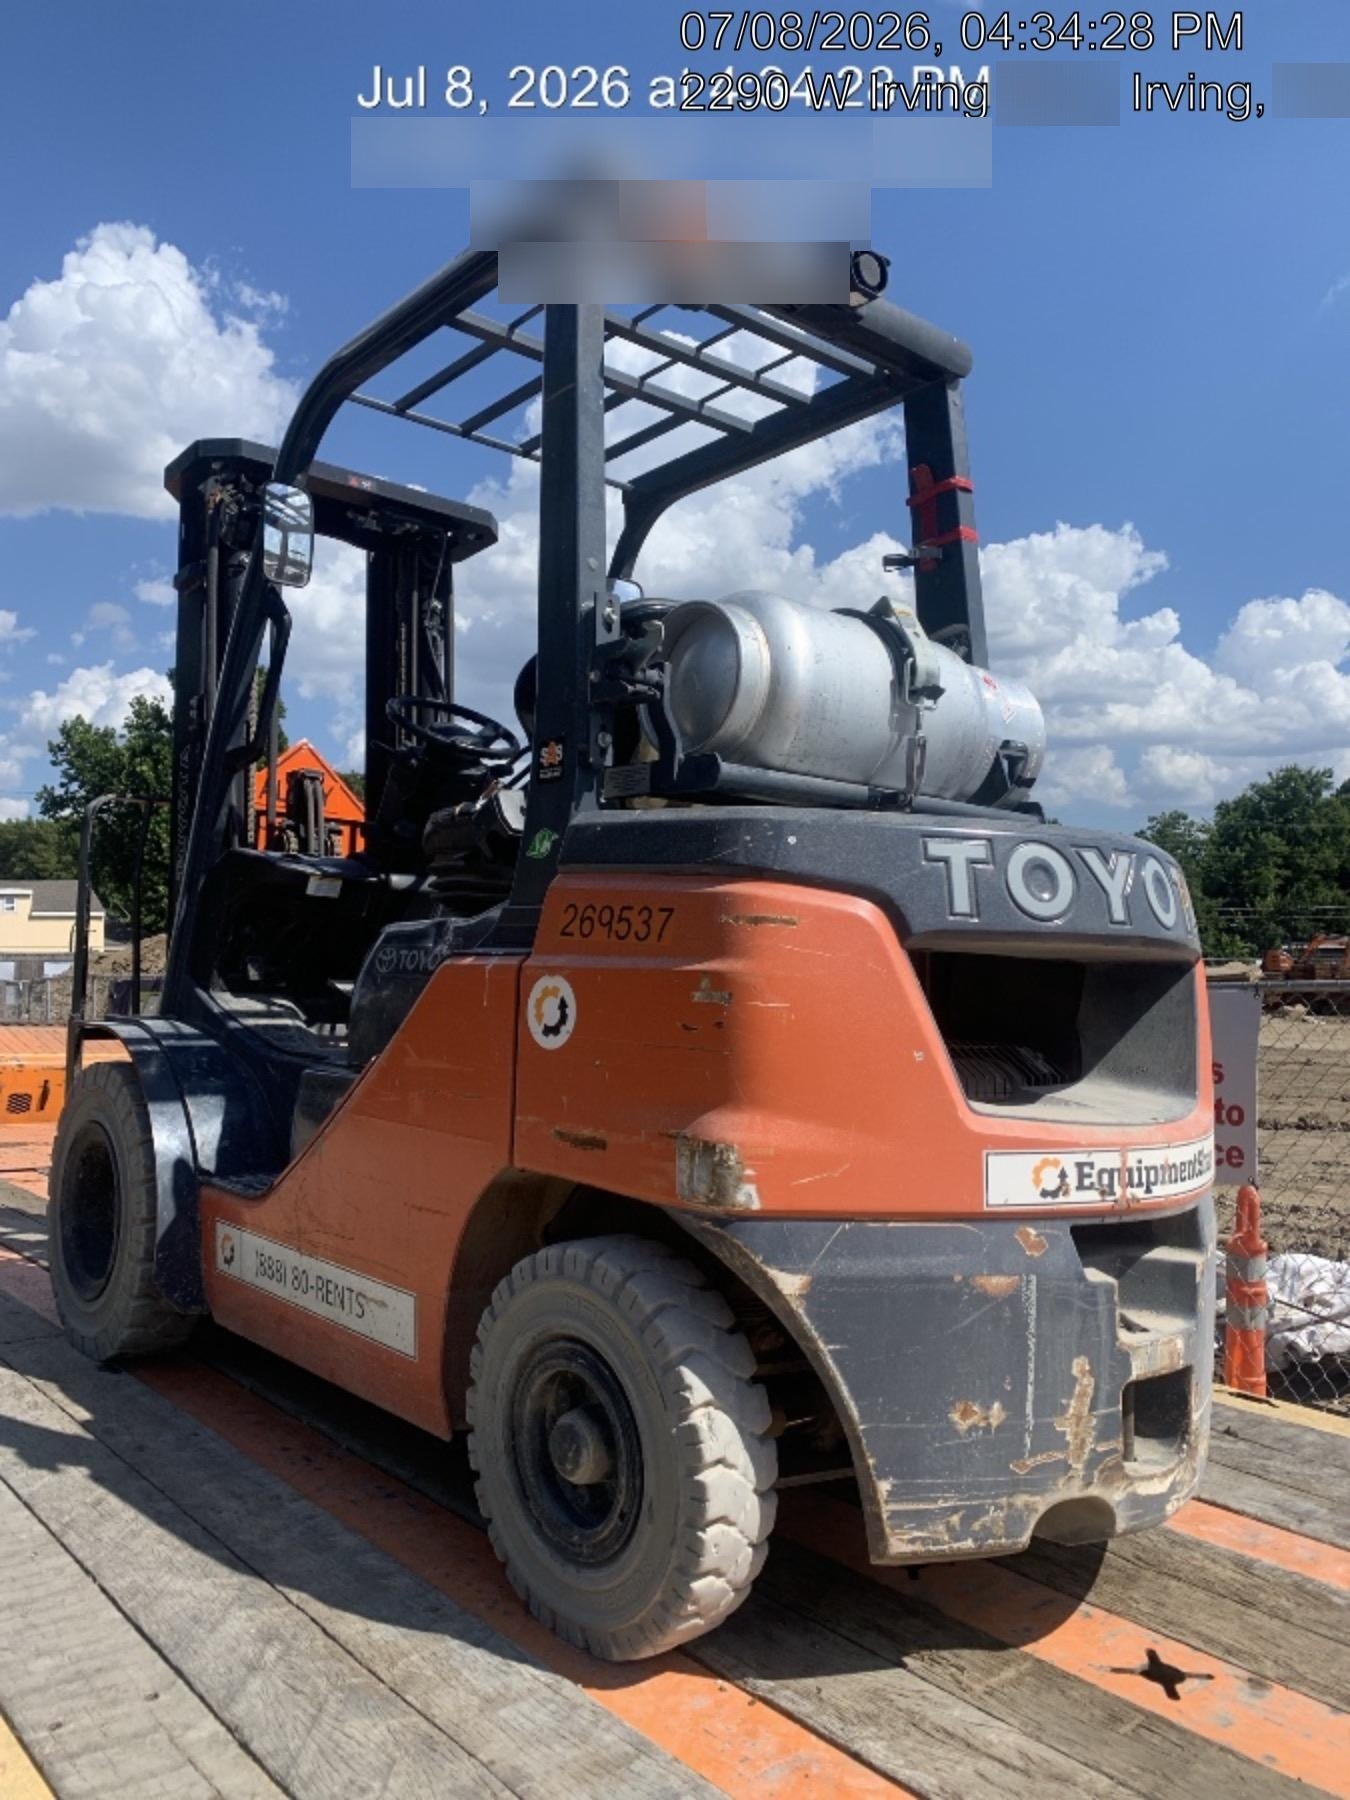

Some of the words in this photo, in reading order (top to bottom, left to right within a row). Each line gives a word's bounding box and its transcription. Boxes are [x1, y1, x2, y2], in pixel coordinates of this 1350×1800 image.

[560, 903, 675, 942] 269537
[399, 948, 443, 971] TOYO
[291, 1265, 367, 1319] 80-RENTS
